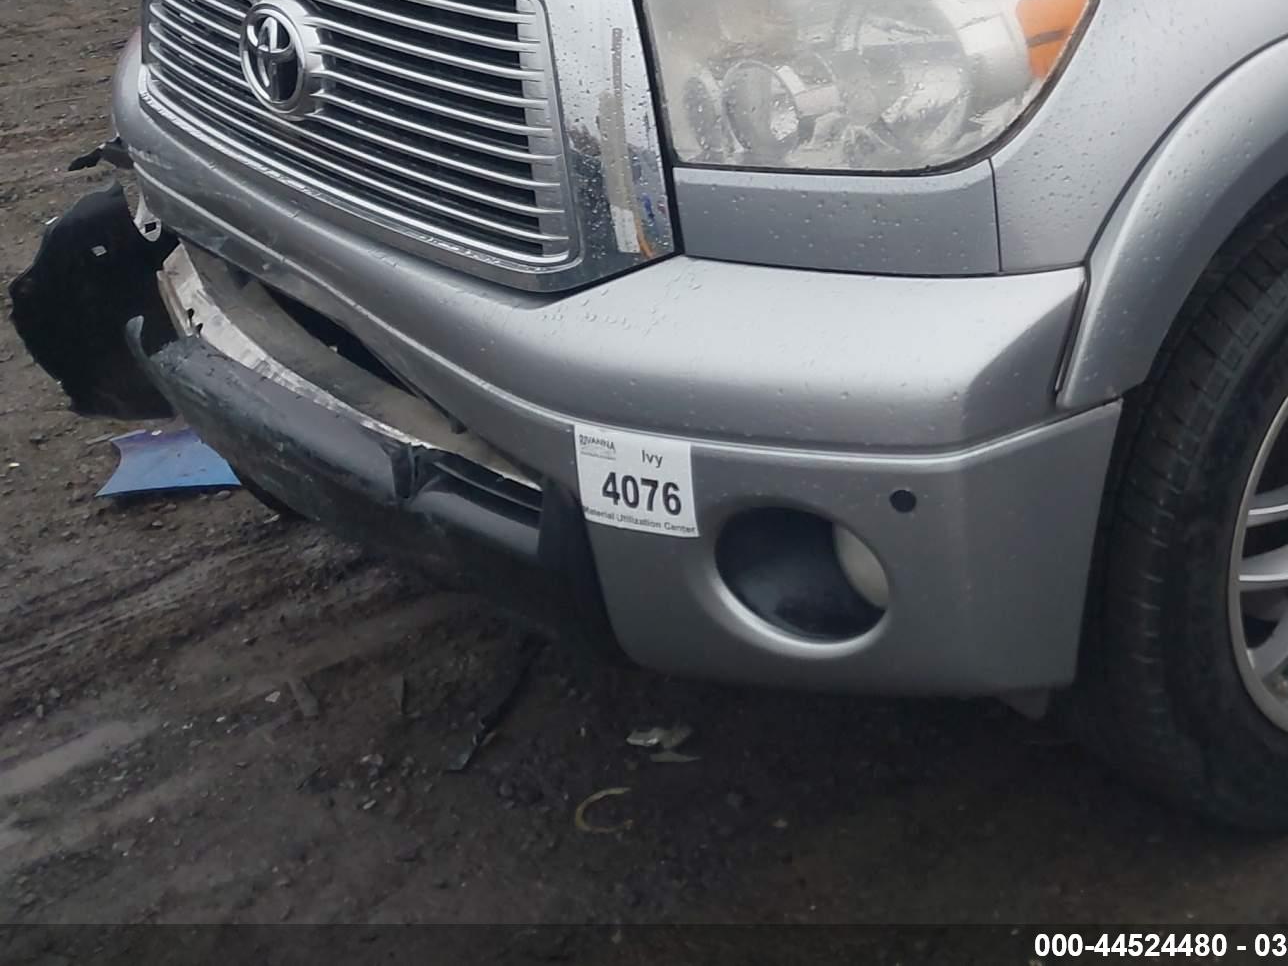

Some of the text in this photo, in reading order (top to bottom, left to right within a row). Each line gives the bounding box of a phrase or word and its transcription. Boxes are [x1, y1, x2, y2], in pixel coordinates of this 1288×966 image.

[641, 450, 663, 469] Ivy
[602, 471, 682, 516] 4076
[617, 514, 662, 529] Utilization
[664, 521, 697, 534] Center
